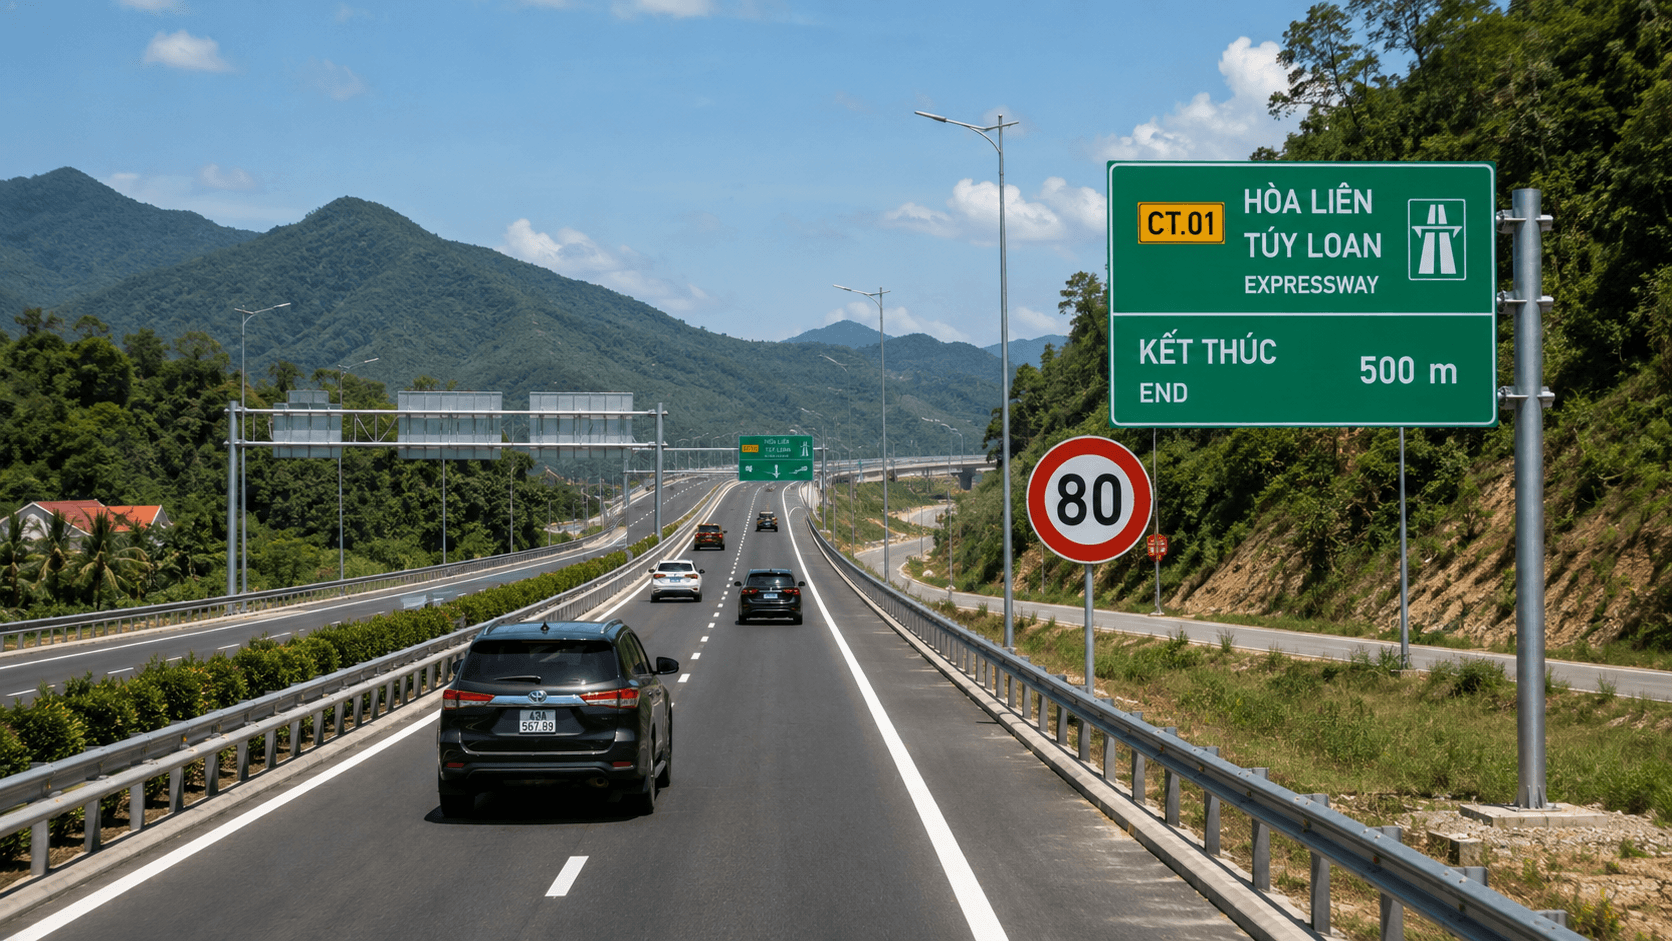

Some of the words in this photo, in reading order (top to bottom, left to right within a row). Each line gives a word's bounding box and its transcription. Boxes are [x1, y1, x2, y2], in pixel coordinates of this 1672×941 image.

[1244, 181, 1302, 214] HÒA
[1311, 181, 1373, 214] LIÊN
[1148, 210, 1214, 236] CT.01
[1243, 225, 1298, 258] TÚY
[1307, 232, 1382, 258] LOAN
[1244, 275, 1379, 294] EXPRESSWAY
[1139, 328, 1194, 365] KẾT
[1201, 331, 1277, 365] THÚC
[1360, 355, 1415, 385] 500
[1429, 363, 1457, 384] m
[1140, 382, 1188, 403] END
[1056, 473, 1122, 527] 80
